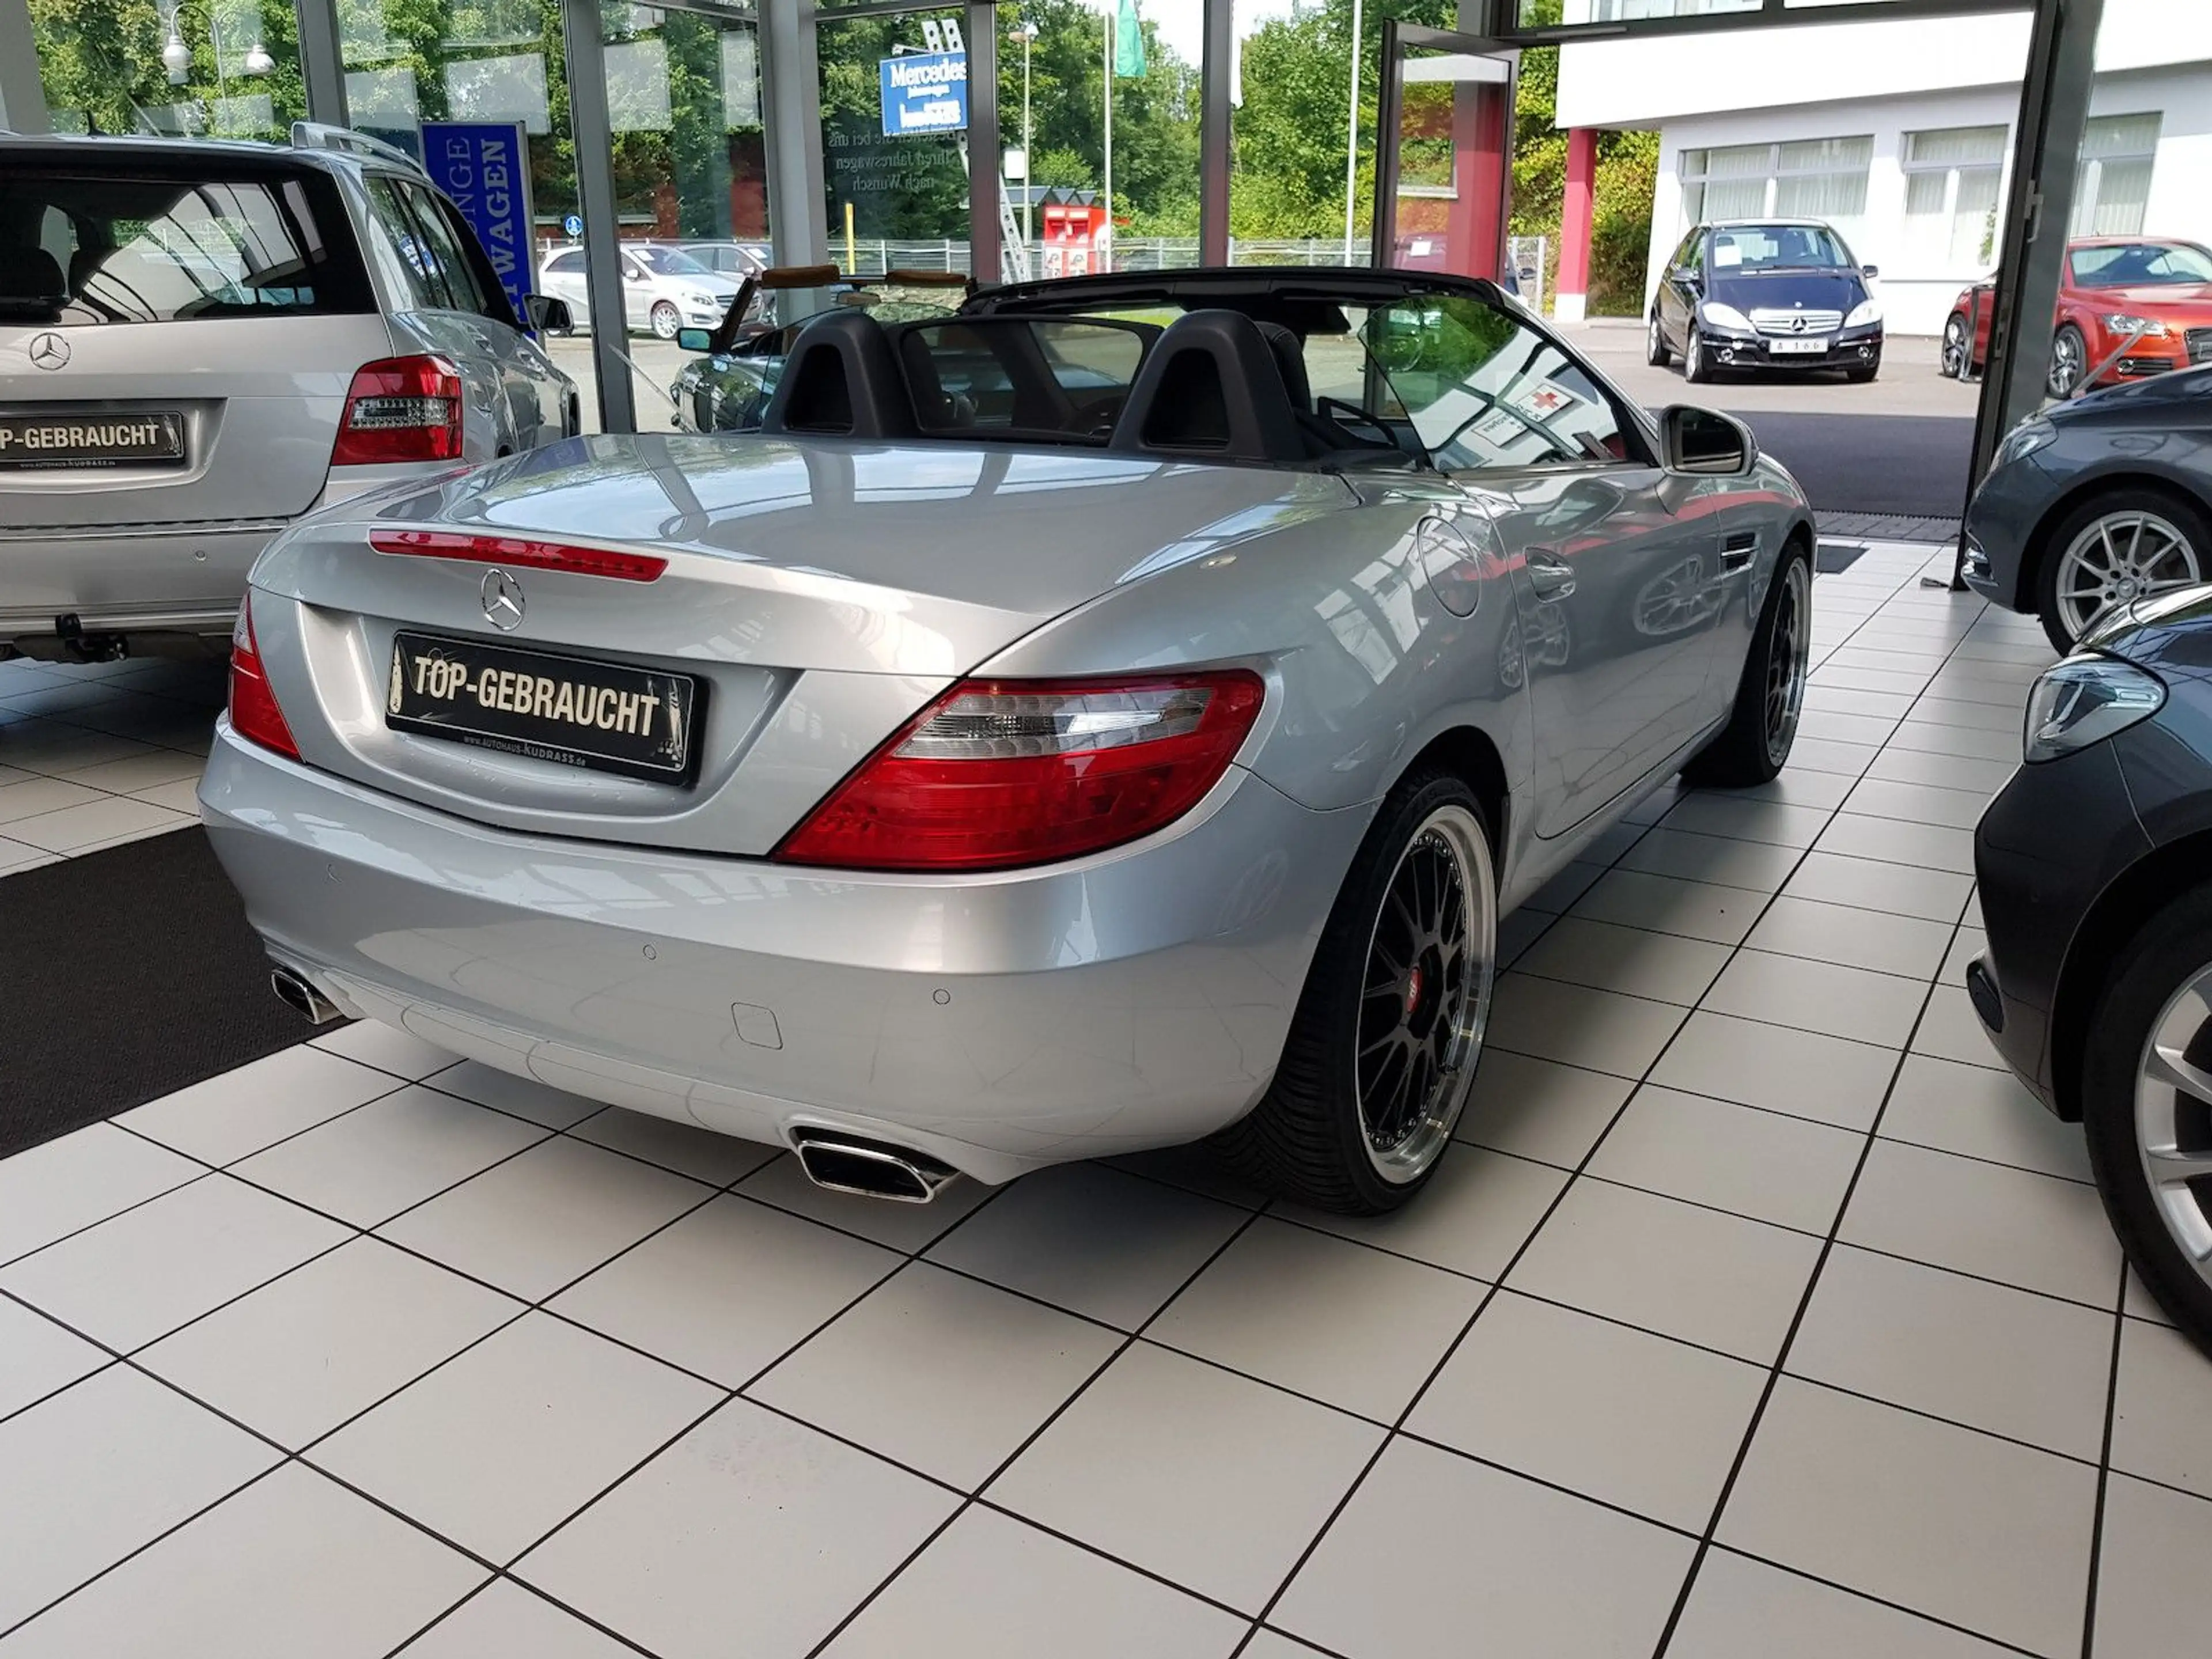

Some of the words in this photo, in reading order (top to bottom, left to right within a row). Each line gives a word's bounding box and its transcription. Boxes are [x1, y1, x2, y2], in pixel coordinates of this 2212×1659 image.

[890, 58, 967, 88] Mercedes
[446, 137, 478, 233] NGE
[0, 425, 160, 450] P-GEBRAUCHT
[414, 656, 660, 737] TOP-GEBRAUCHT
